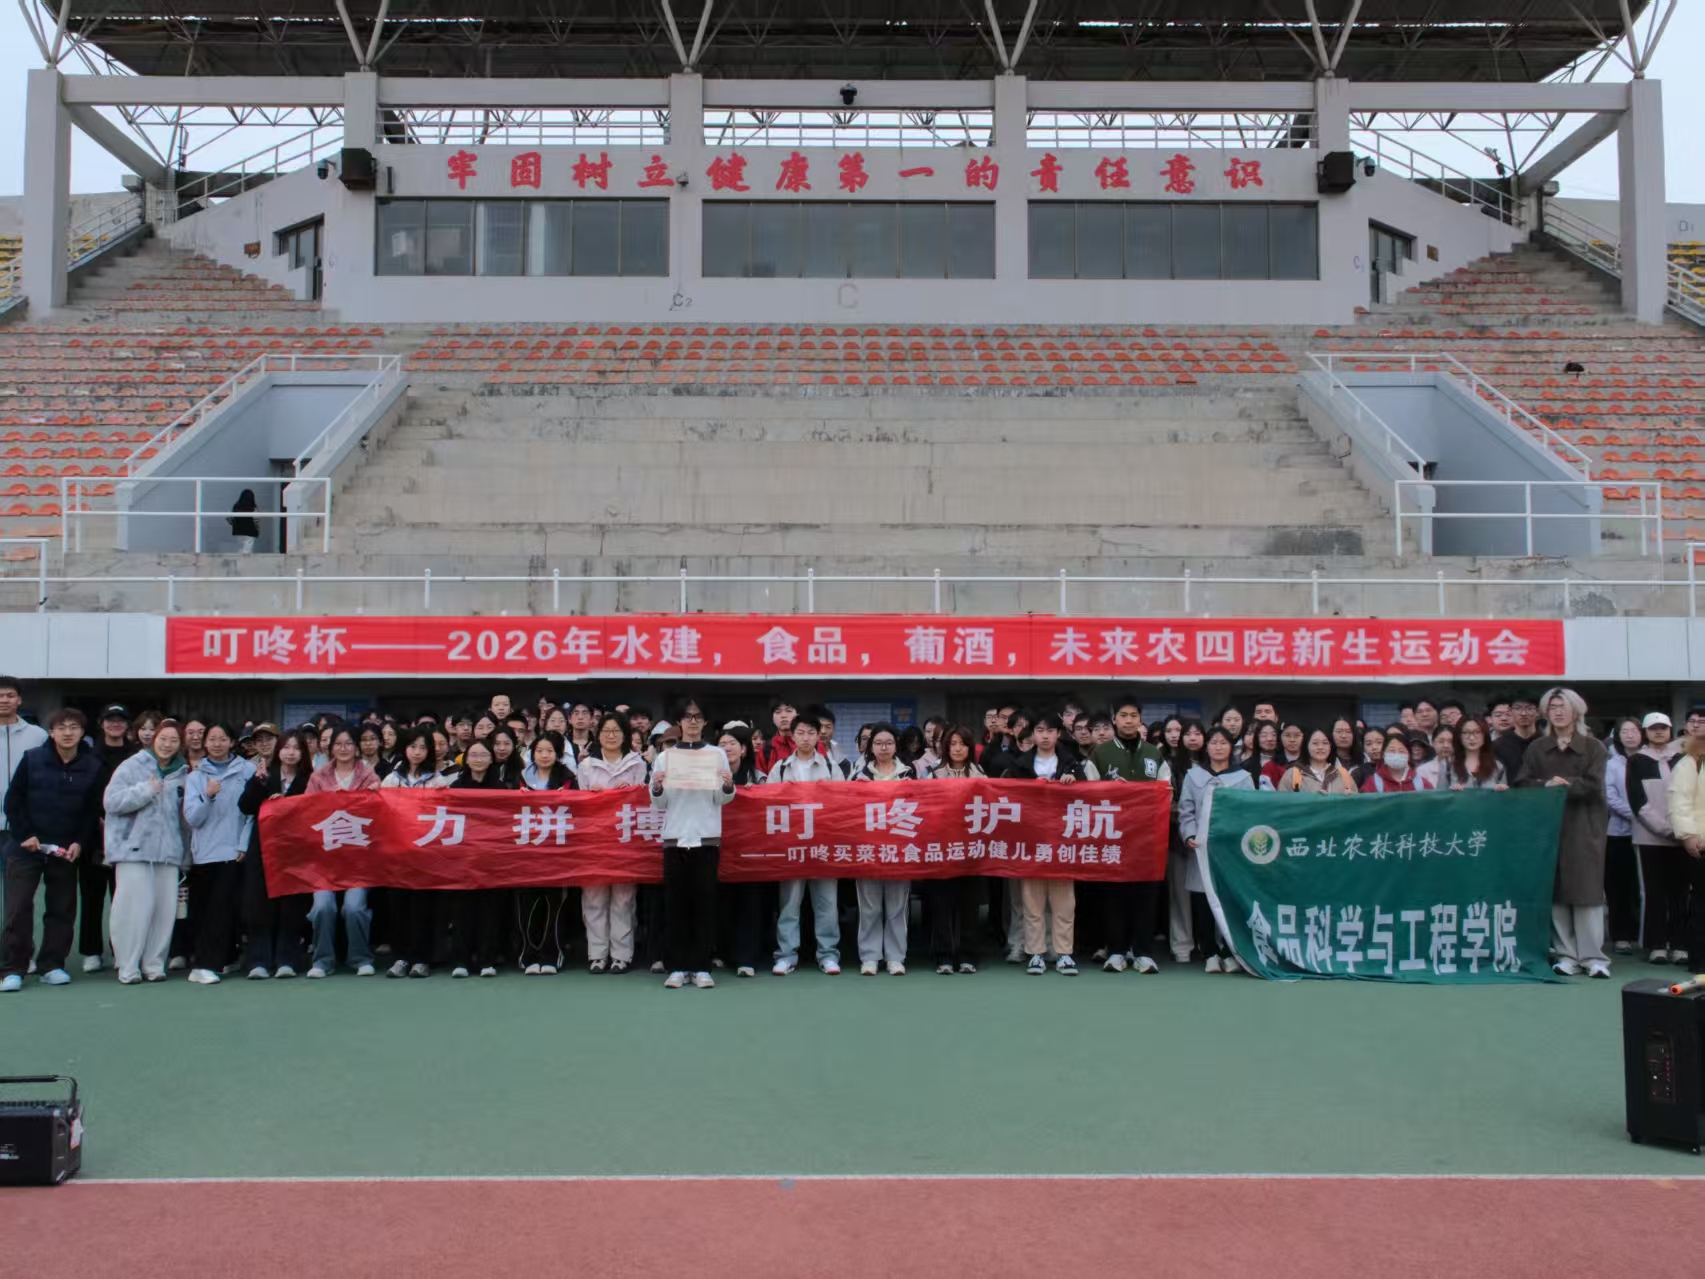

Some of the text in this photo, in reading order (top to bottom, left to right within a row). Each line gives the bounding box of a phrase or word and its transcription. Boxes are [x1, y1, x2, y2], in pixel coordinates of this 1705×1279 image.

[447, 150, 1264, 193] 牢固树立健康第一的责任意识
[1285, 830, 1487, 861] 西北农林科技大学
[1247, 900, 1522, 976] 食品科学与工程学院
